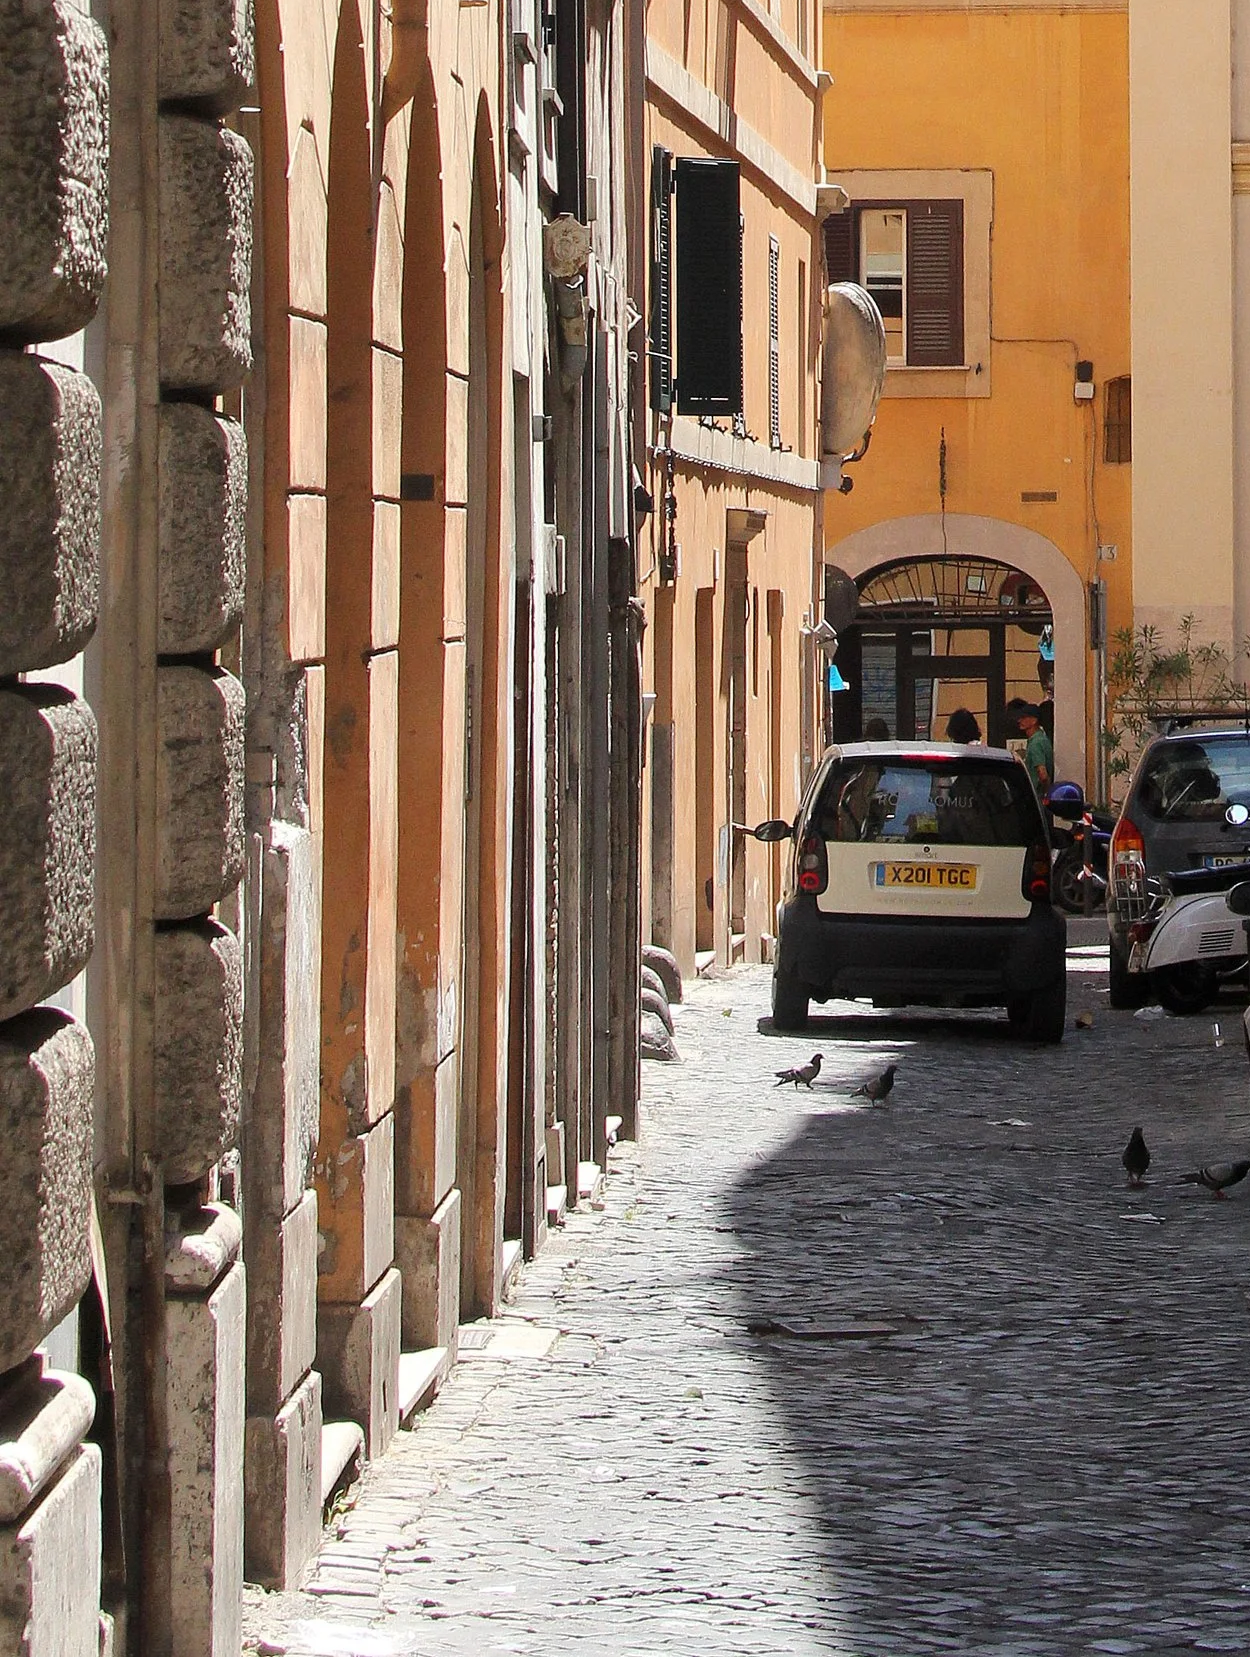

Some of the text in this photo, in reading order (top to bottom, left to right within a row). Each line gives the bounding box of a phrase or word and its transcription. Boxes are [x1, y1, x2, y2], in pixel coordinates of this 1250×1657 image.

[930, 795, 974, 808] OMUS
[891, 866, 970, 885] X201 TGC
